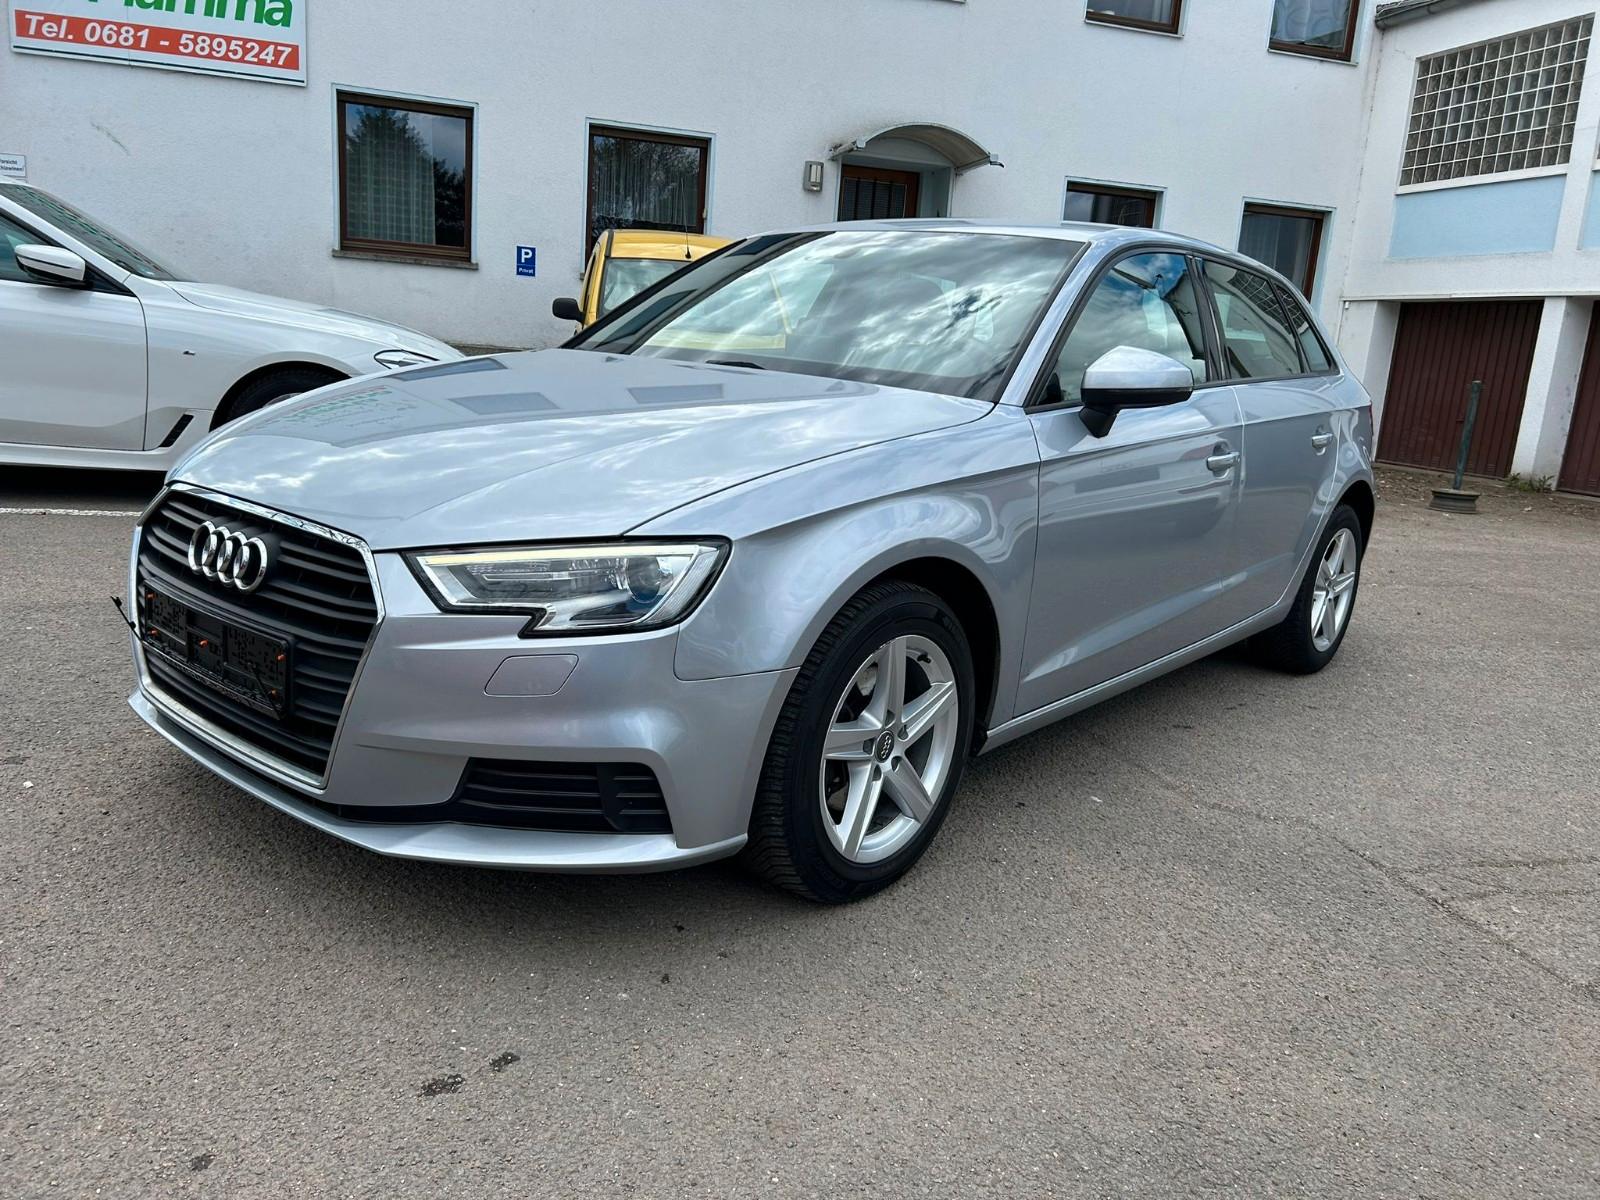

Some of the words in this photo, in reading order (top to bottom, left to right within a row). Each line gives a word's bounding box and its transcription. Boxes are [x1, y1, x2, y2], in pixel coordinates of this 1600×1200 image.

[25, 14, 74, 40] Tel.
[84, 21, 150, 49] 0681
[178, 33, 293, 66] 5895247
[521, 248, 533, 263] P
